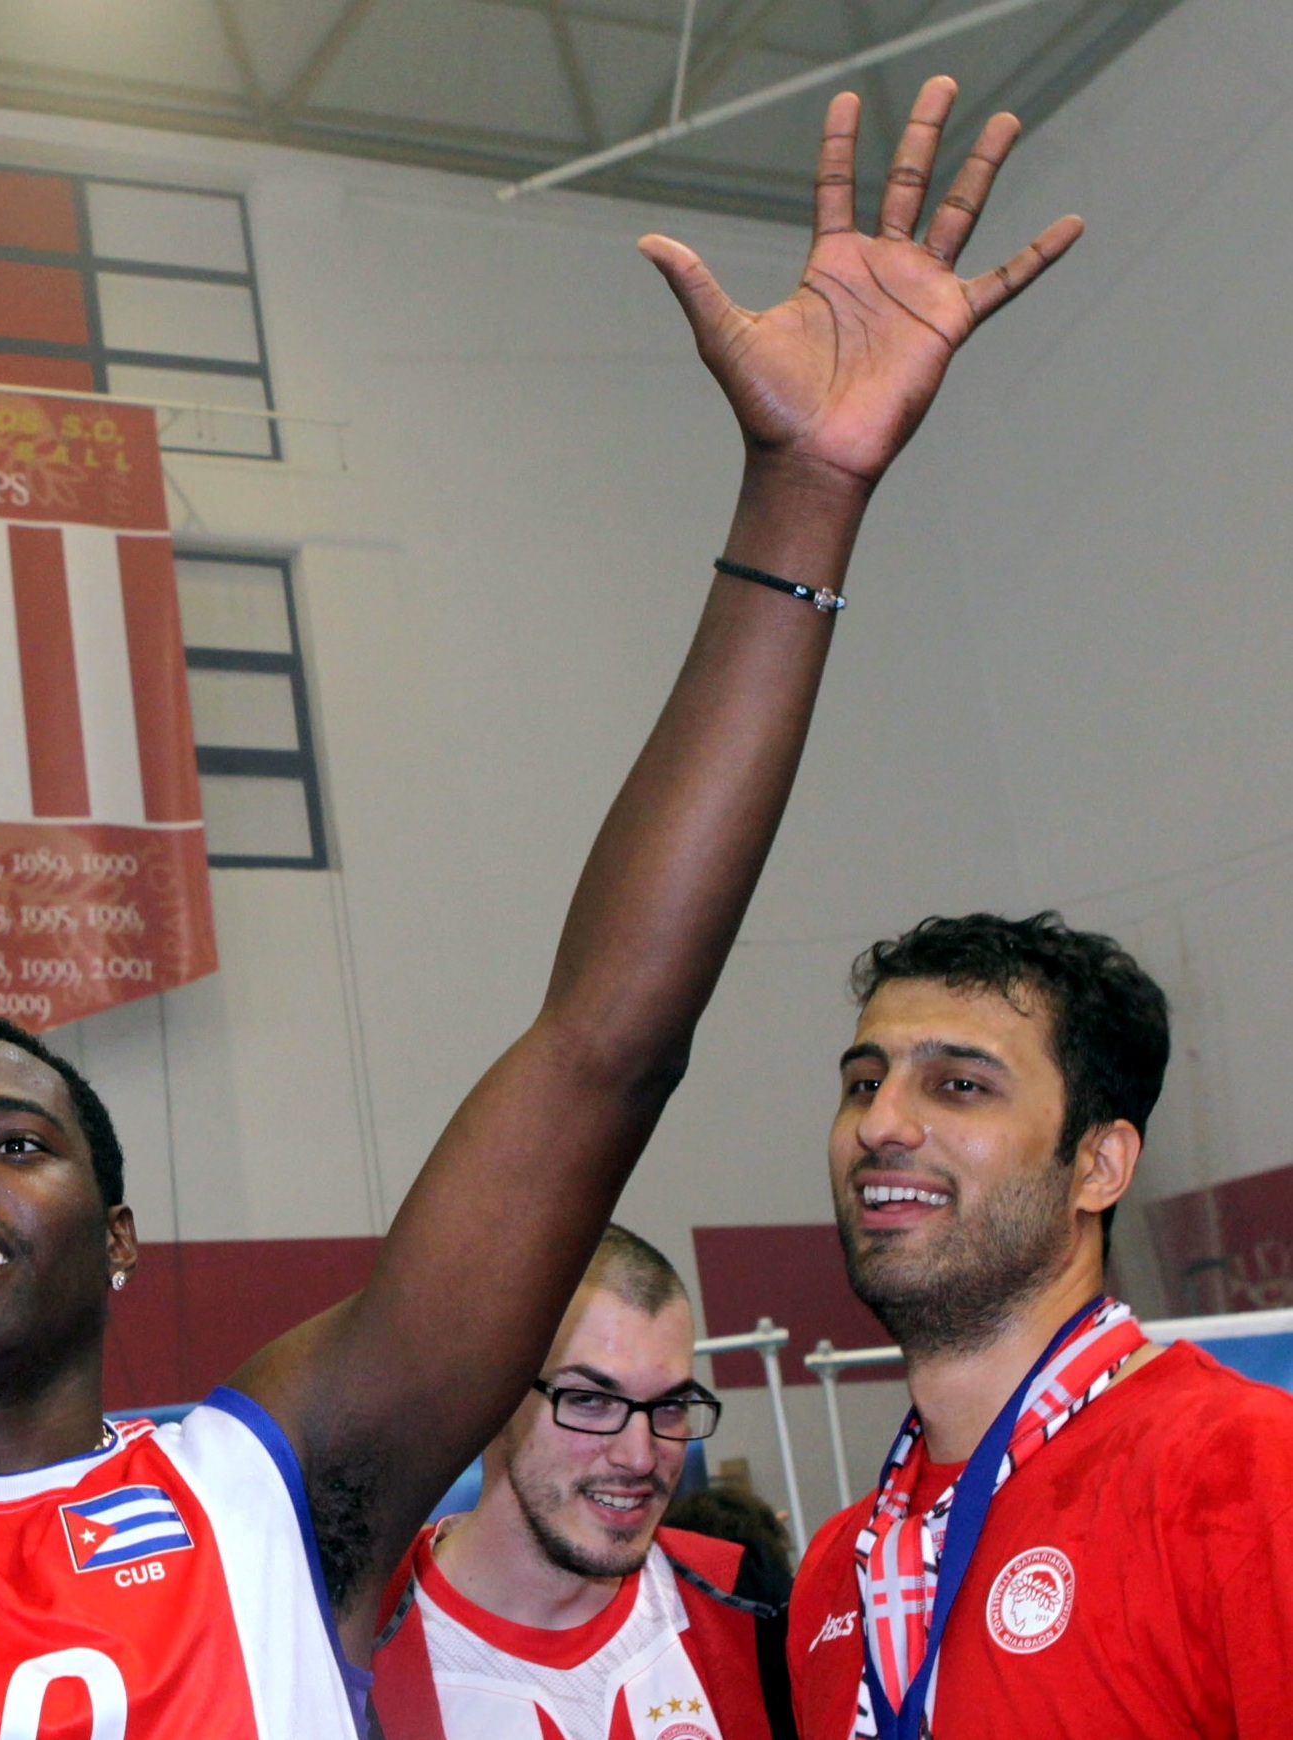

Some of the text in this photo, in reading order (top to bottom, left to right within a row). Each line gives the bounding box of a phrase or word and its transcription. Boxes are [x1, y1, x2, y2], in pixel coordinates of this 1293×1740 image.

[12, 847, 73, 880] 1989,
[82, 852, 138, 881] 1990
[88, 902, 145, 938] 1996,
[20, 959, 83, 987] 1999,
[90, 956, 153, 982] 2001
[114, 1561, 166, 1588] CUB
